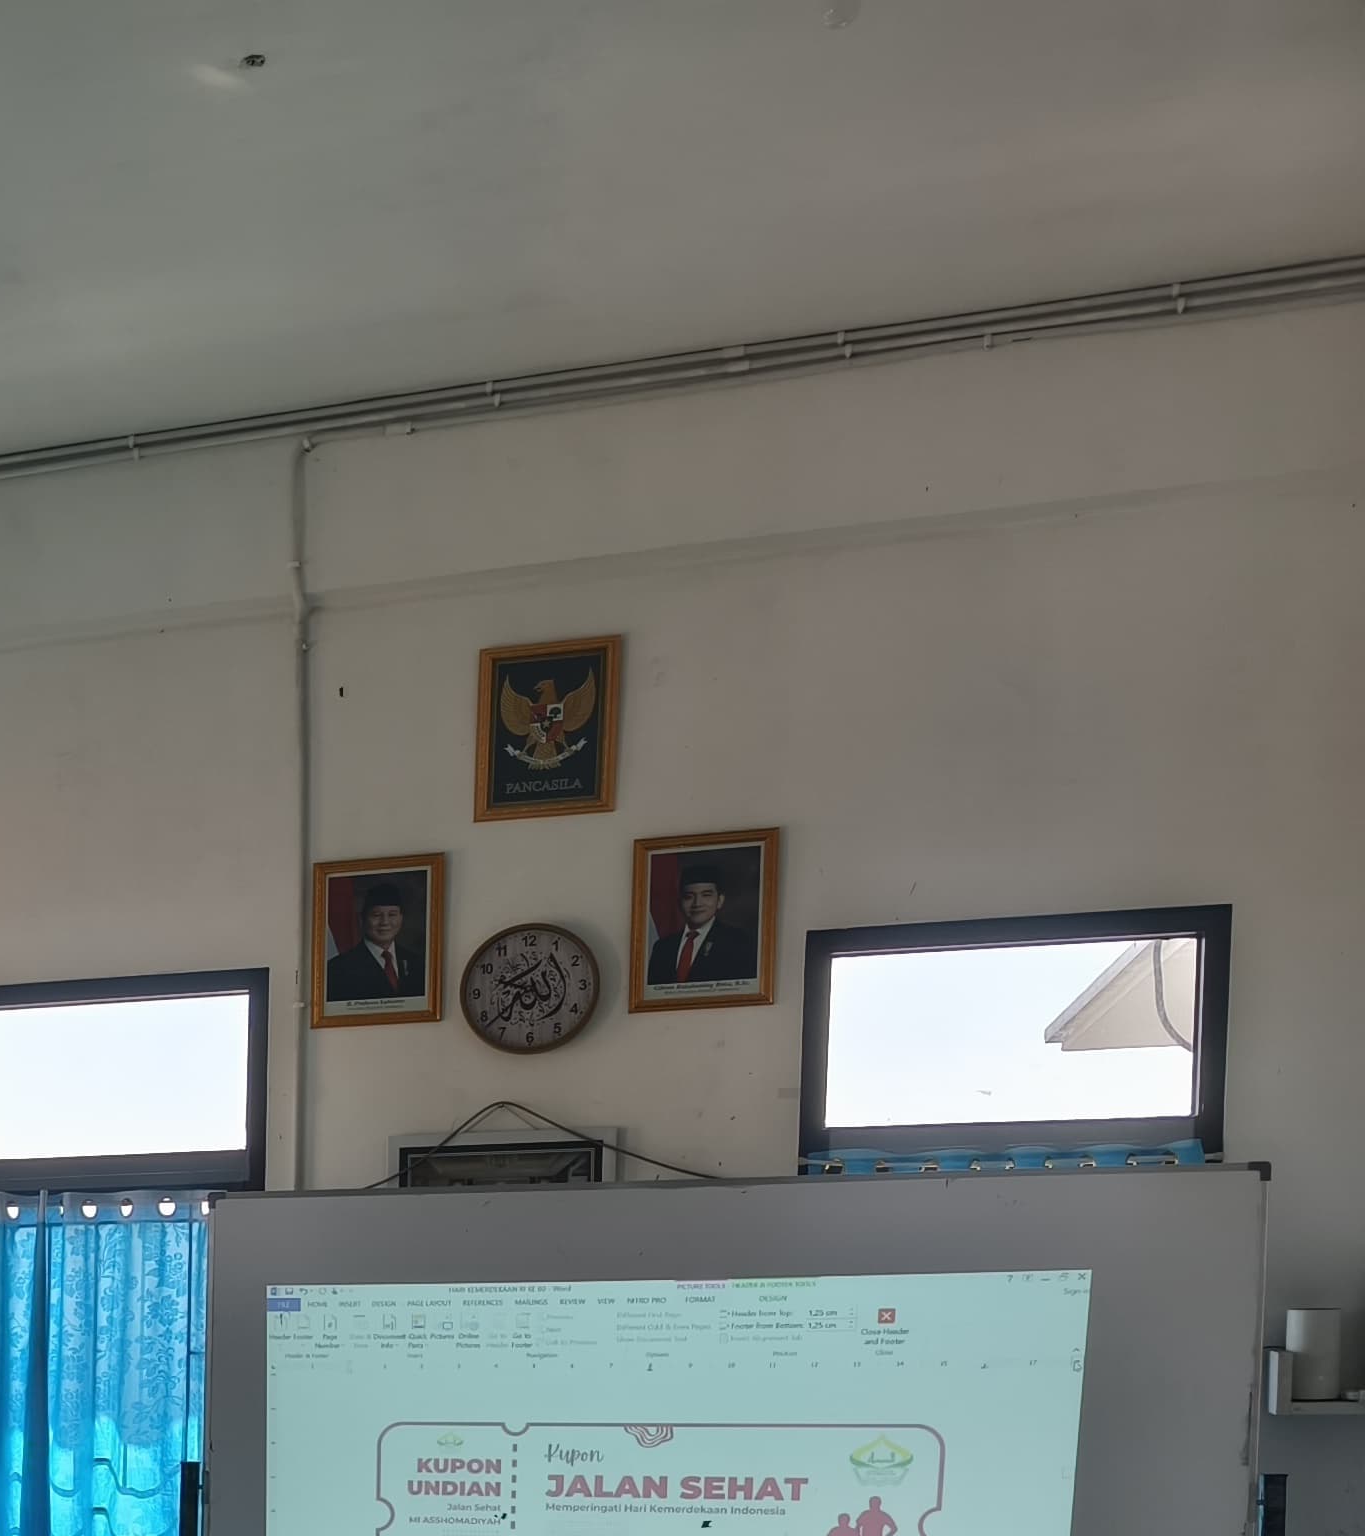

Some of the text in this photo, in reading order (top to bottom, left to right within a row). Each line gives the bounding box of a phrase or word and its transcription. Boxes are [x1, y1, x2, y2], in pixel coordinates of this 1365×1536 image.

[505, 778, 584, 794] PANCASILA
[522, 935, 536, 947] 12
[552, 940, 559, 952] 1
[496, 945, 507, 957] 11
[571, 955, 580, 967] 2
[480, 963, 493, 975] 10
[579, 979, 588, 991] 3
[472, 988, 481, 1000] 9
[570, 1003, 578, 1015] 4
[480, 1010, 488, 1022] 8
[498, 1027, 507, 1038] 7
[553, 1022, 562, 1034] 5
[526, 1031, 534, 1043] 6
[307, 1300, 328, 1308] HOME
[861, 1328, 909, 1336] Close Header
[863, 1337, 905, 1345] and Footer
[544, 1444, 604, 1466] Kupon
[417, 1457, 502, 1475] KUPON
[407, 1479, 501, 1497] UNDIAN
[545, 1474, 809, 1501] JALAN SEHAT
[447, 1503, 501, 1512] Jalan Sehat
[545, 1503, 786, 1516] Memperingati Hari Kemerdekaan Indonesia
[409, 1516, 501, 1526] MI ASSHOMADIYAH
